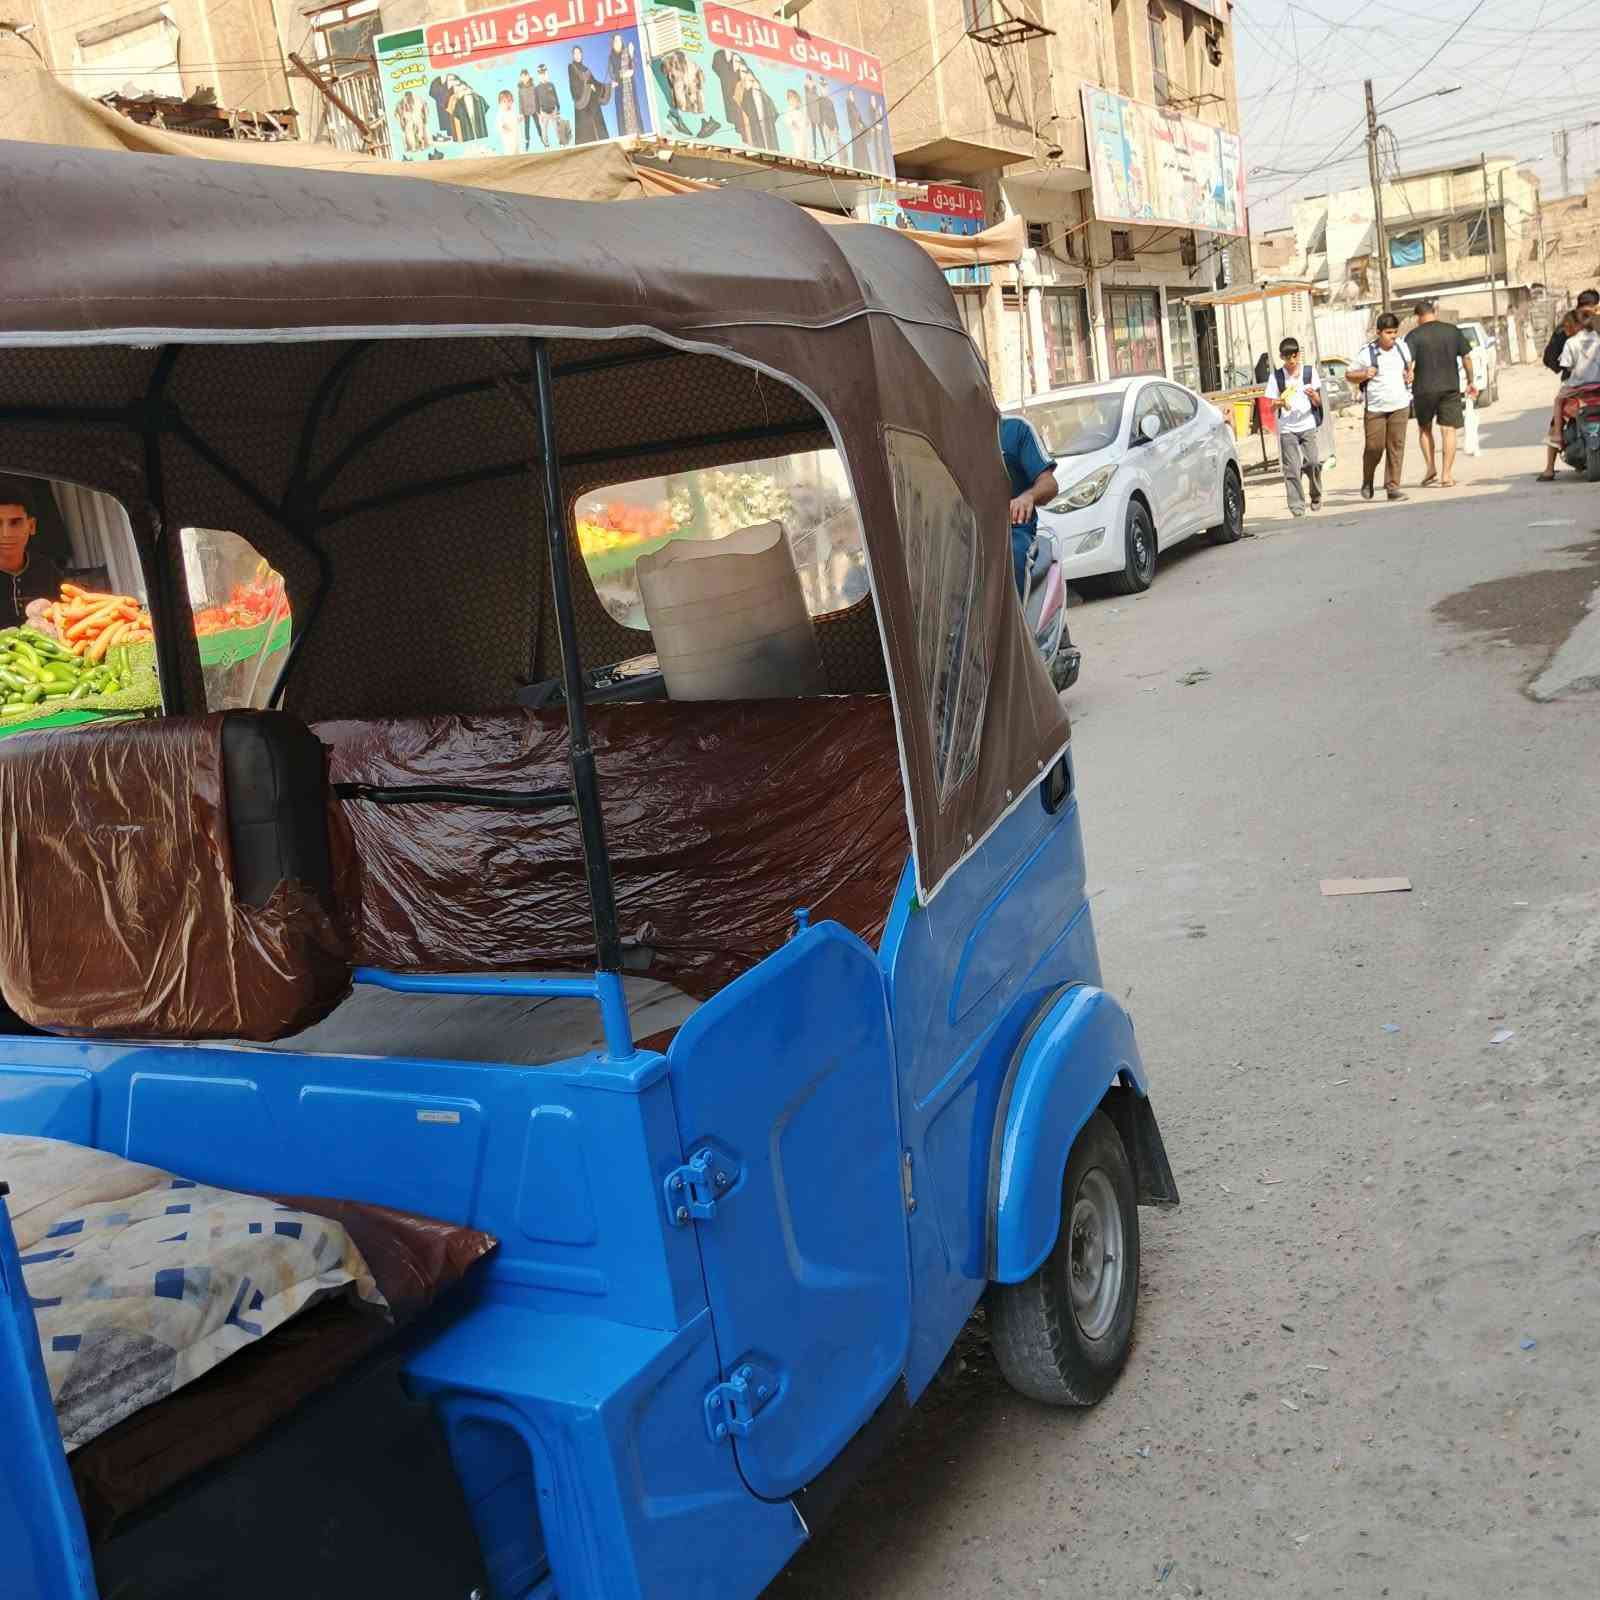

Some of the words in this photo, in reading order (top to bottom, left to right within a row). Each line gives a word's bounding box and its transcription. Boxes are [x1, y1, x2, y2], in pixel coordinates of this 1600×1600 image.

[507, 0, 585, 44] الودق
[594, 0, 629, 26] دار
[431, 19, 497, 59] للأزياء
[711, 13, 781, 49] للأزياء
[789, 38, 850, 73] الودق
[856, 59, 879, 82] دار
[932, 189, 966, 211] الودق
[968, 192, 982, 214] دار
